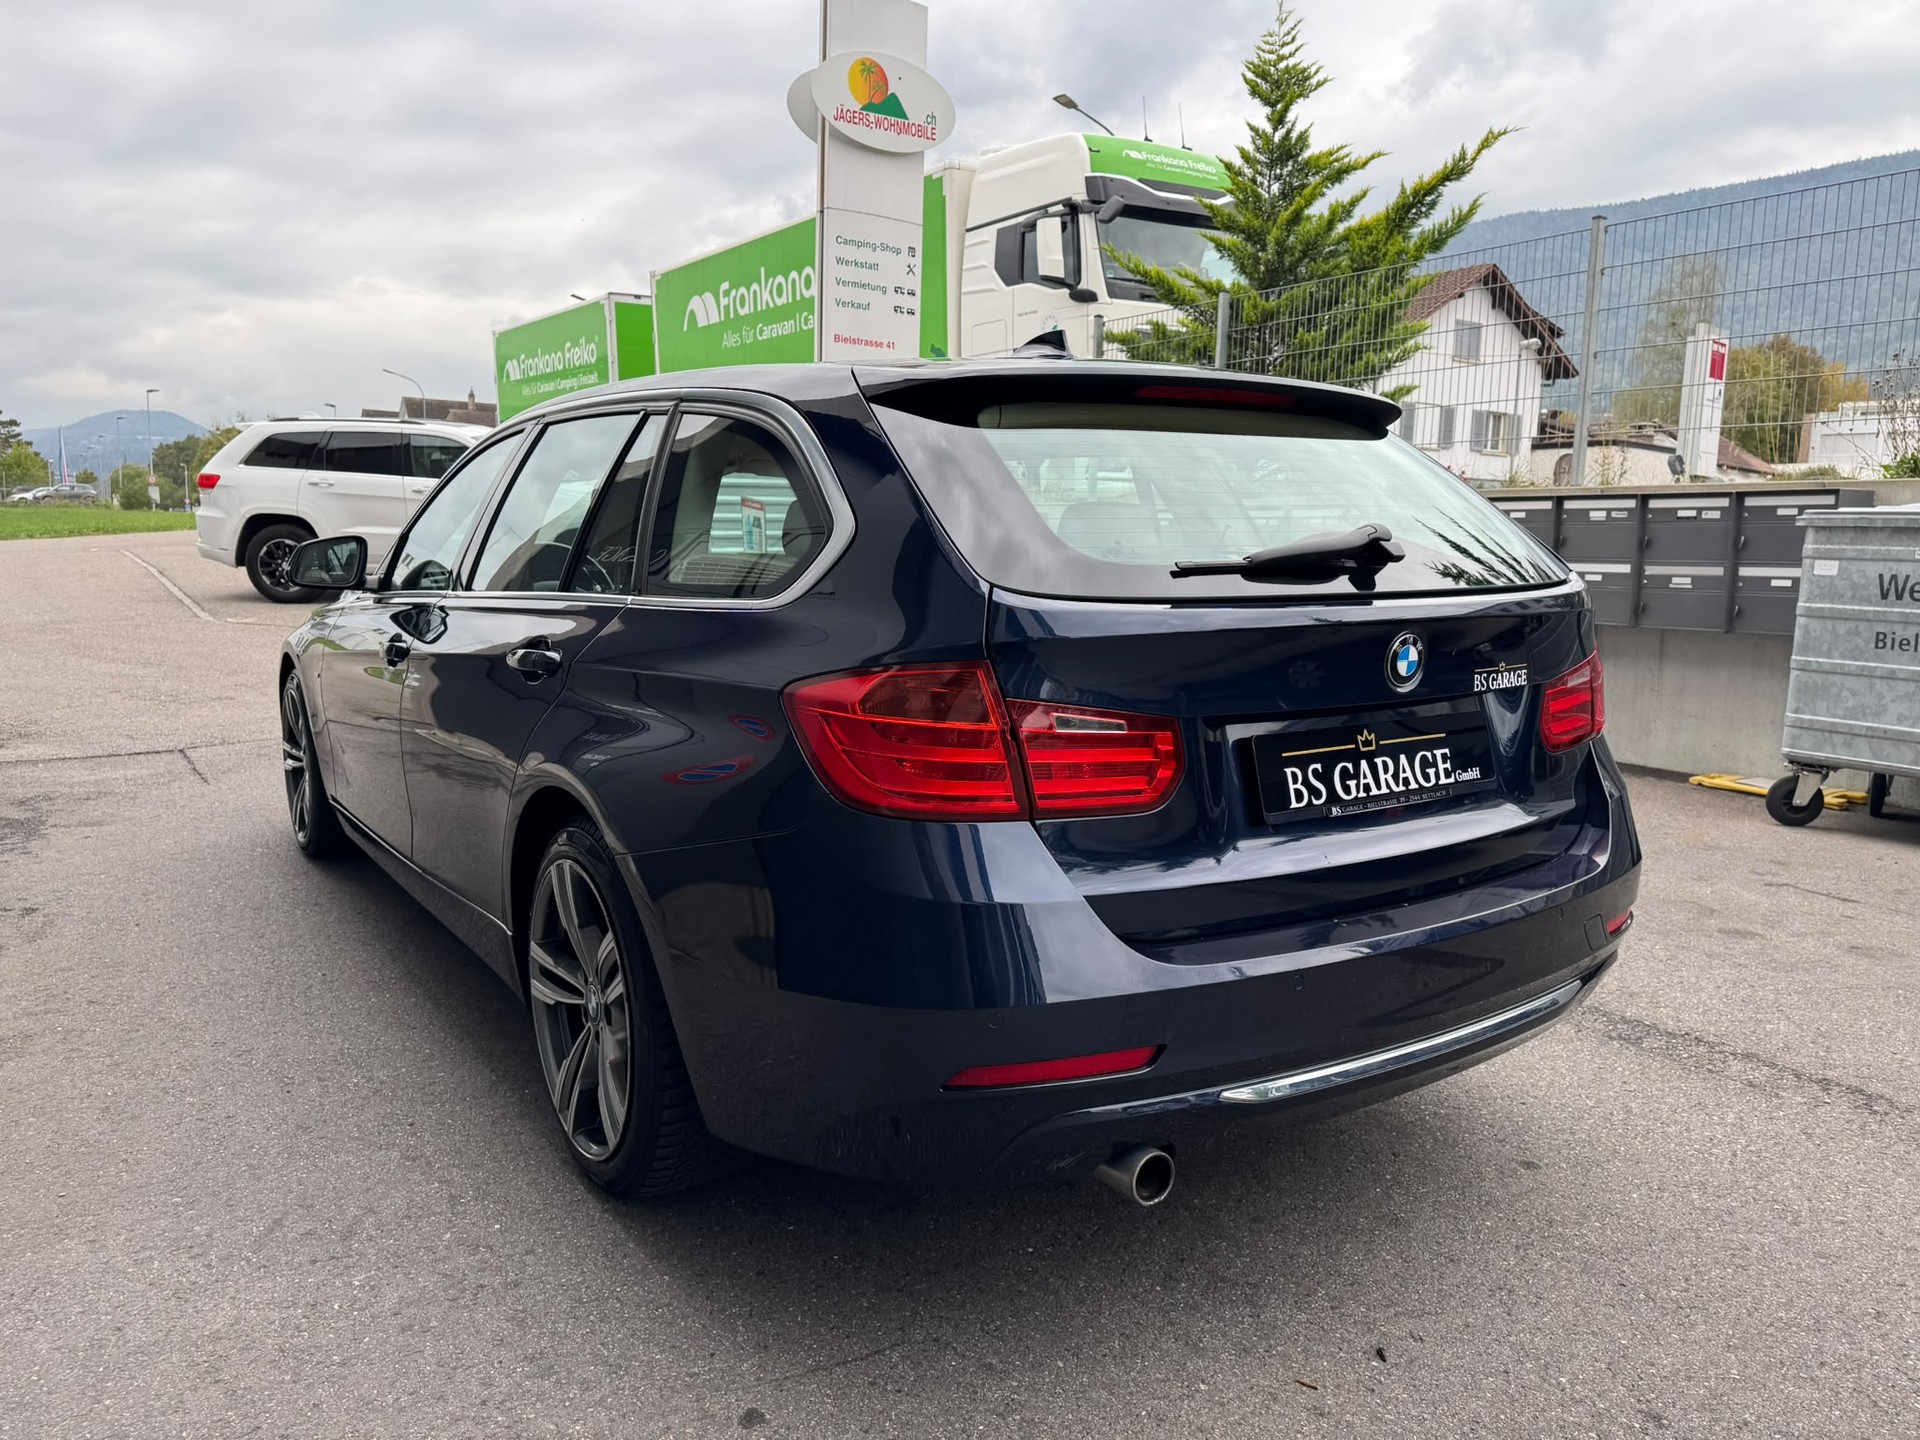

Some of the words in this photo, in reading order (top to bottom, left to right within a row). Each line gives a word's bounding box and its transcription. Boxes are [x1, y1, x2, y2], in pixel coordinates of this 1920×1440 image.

[835, 235, 902, 256] Camping-Shop
[835, 256, 880, 271] Werkstatt
[719, 266, 816, 322] Frankana
[835, 277, 888, 295] Vermietung
[834, 298, 871, 312] Verkauf
[722, 329, 741, 349] Alles
[742, 326, 754, 345] für
[756, 318, 795, 341] Caravan
[833, 333, 884, 349] Bielstrasse
[885, 340, 896, 350] 41
[520, 347, 564, 379] Frankana
[564, 336, 597, 369] Freiko
[1874, 631, 1920, 653] Biel
[1473, 673, 1487, 692] BS
[1489, 669, 1528, 690] GARAGE
[1283, 763, 1328, 809] BS
[1333, 748, 1455, 801] GARAGE
[1455, 767, 1481, 782] GmbH
[1331, 805, 1342, 816] BS
[1342, 804, 1363, 813] GARAGE
